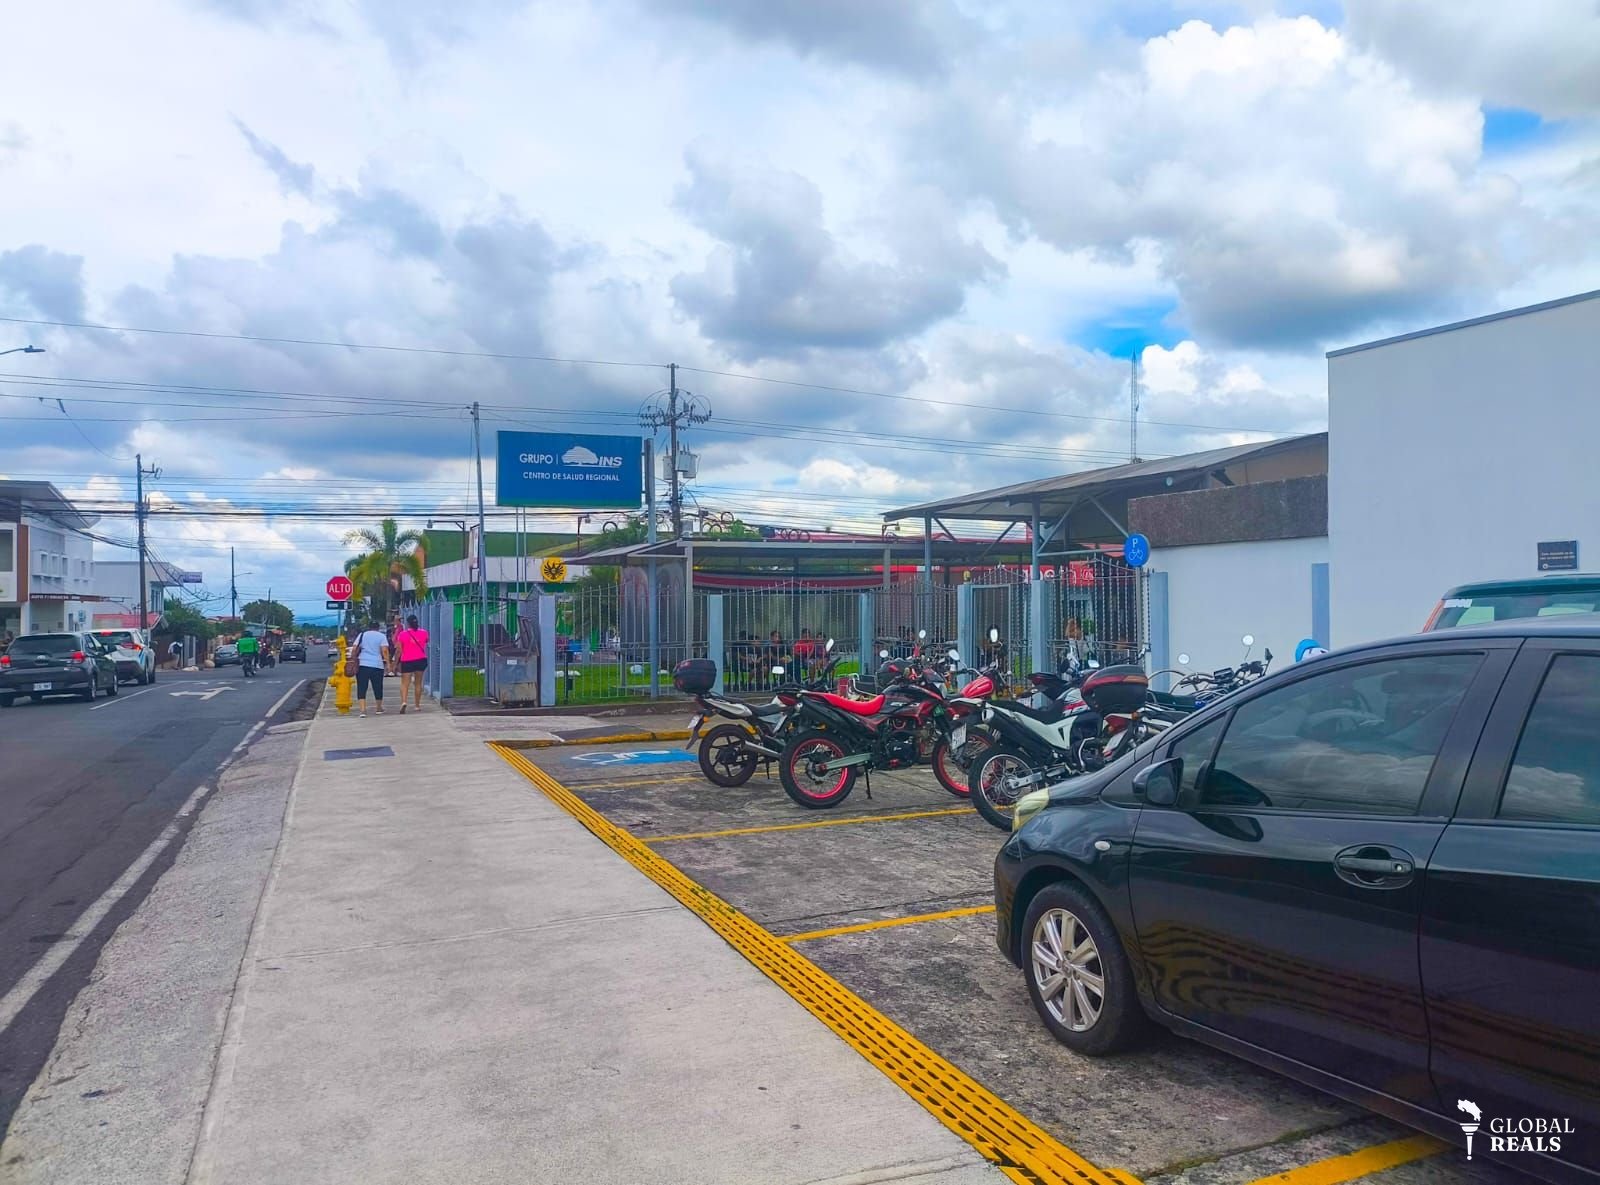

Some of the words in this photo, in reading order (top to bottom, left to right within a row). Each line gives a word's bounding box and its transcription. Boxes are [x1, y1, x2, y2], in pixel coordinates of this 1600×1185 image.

[519, 453, 553, 465] GRUPO
[599, 455, 623, 467] INS
[523, 471, 550, 480] CENTRO
[552, 472, 562, 480] DE
[562, 472, 584, 481] SALUD
[586, 473, 620, 482] REGIONAL
[1132, 538, 1138, 548] P
[329, 584, 351, 593] ALTO
